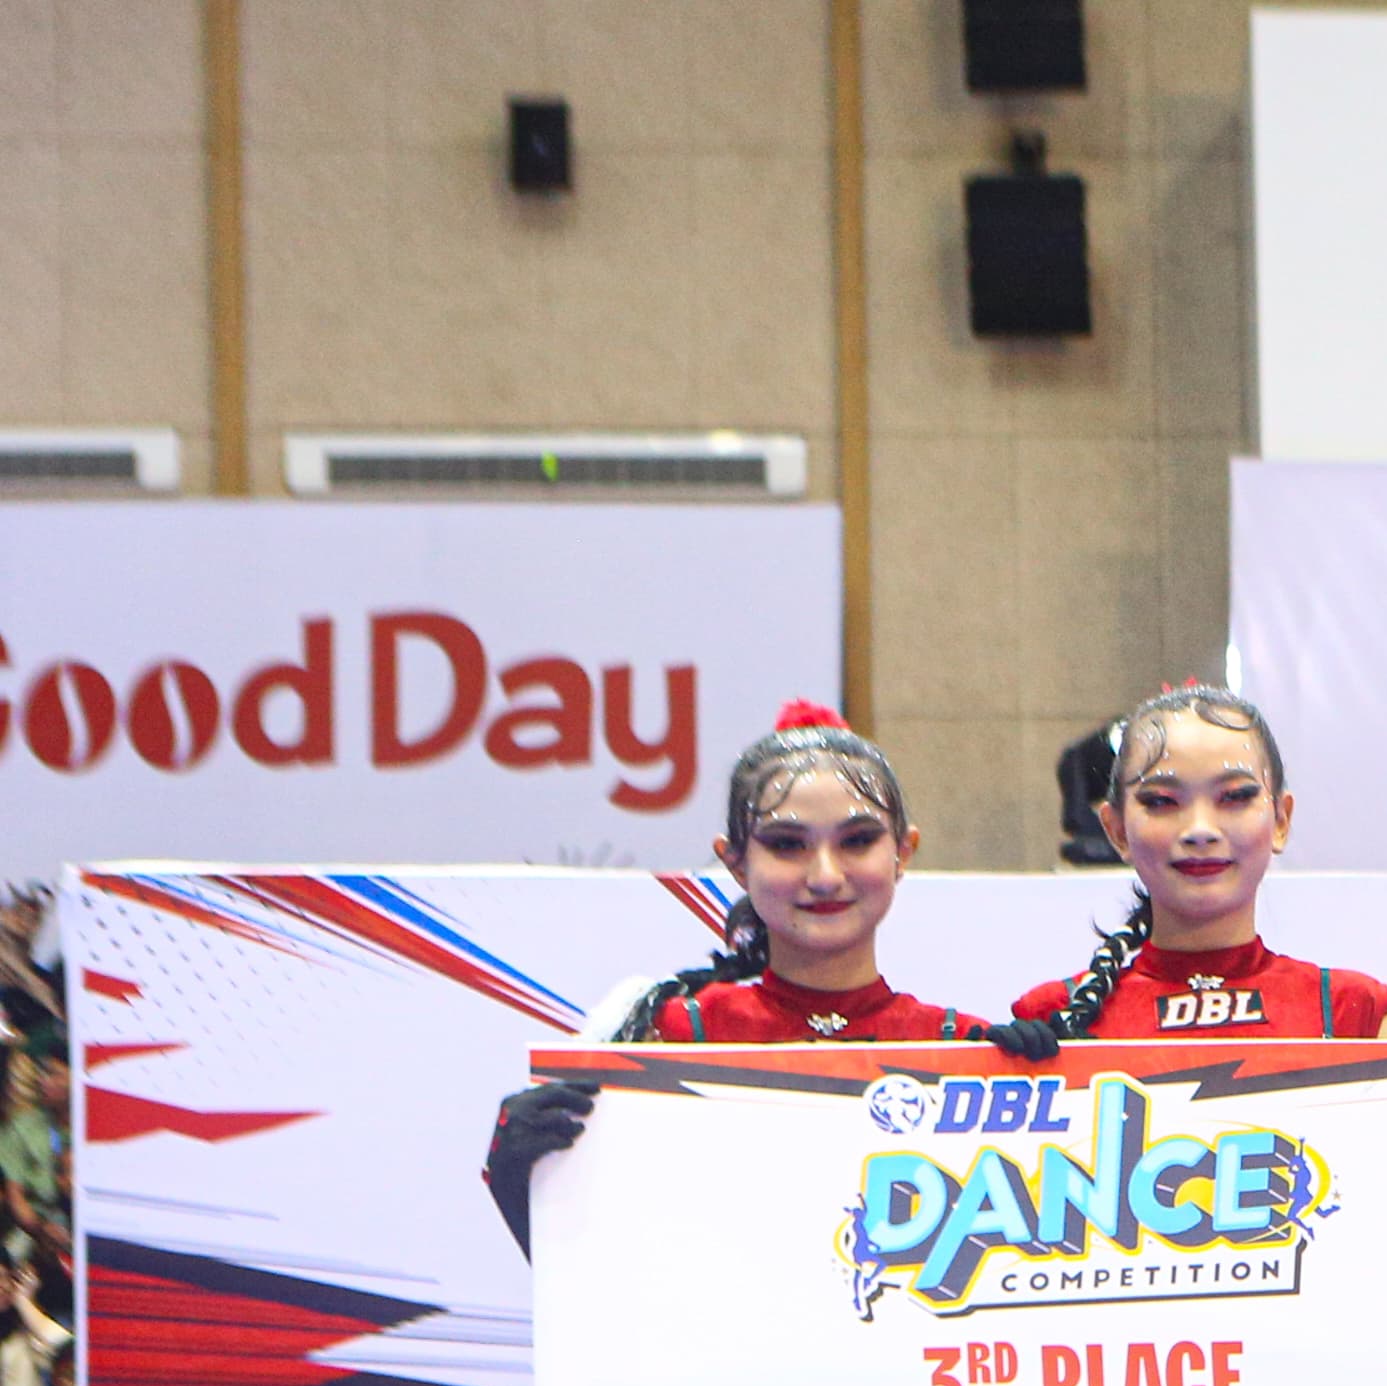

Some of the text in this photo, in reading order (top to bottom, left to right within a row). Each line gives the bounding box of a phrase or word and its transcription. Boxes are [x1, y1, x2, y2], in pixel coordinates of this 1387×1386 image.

[0, 610, 699, 814] ood Day
[1160, 990, 1263, 1029] DBL
[933, 1080, 1071, 1133] DBL
[863, 1080, 1292, 1298] DANCE
[1000, 1259, 1282, 1293] COMPETITION
